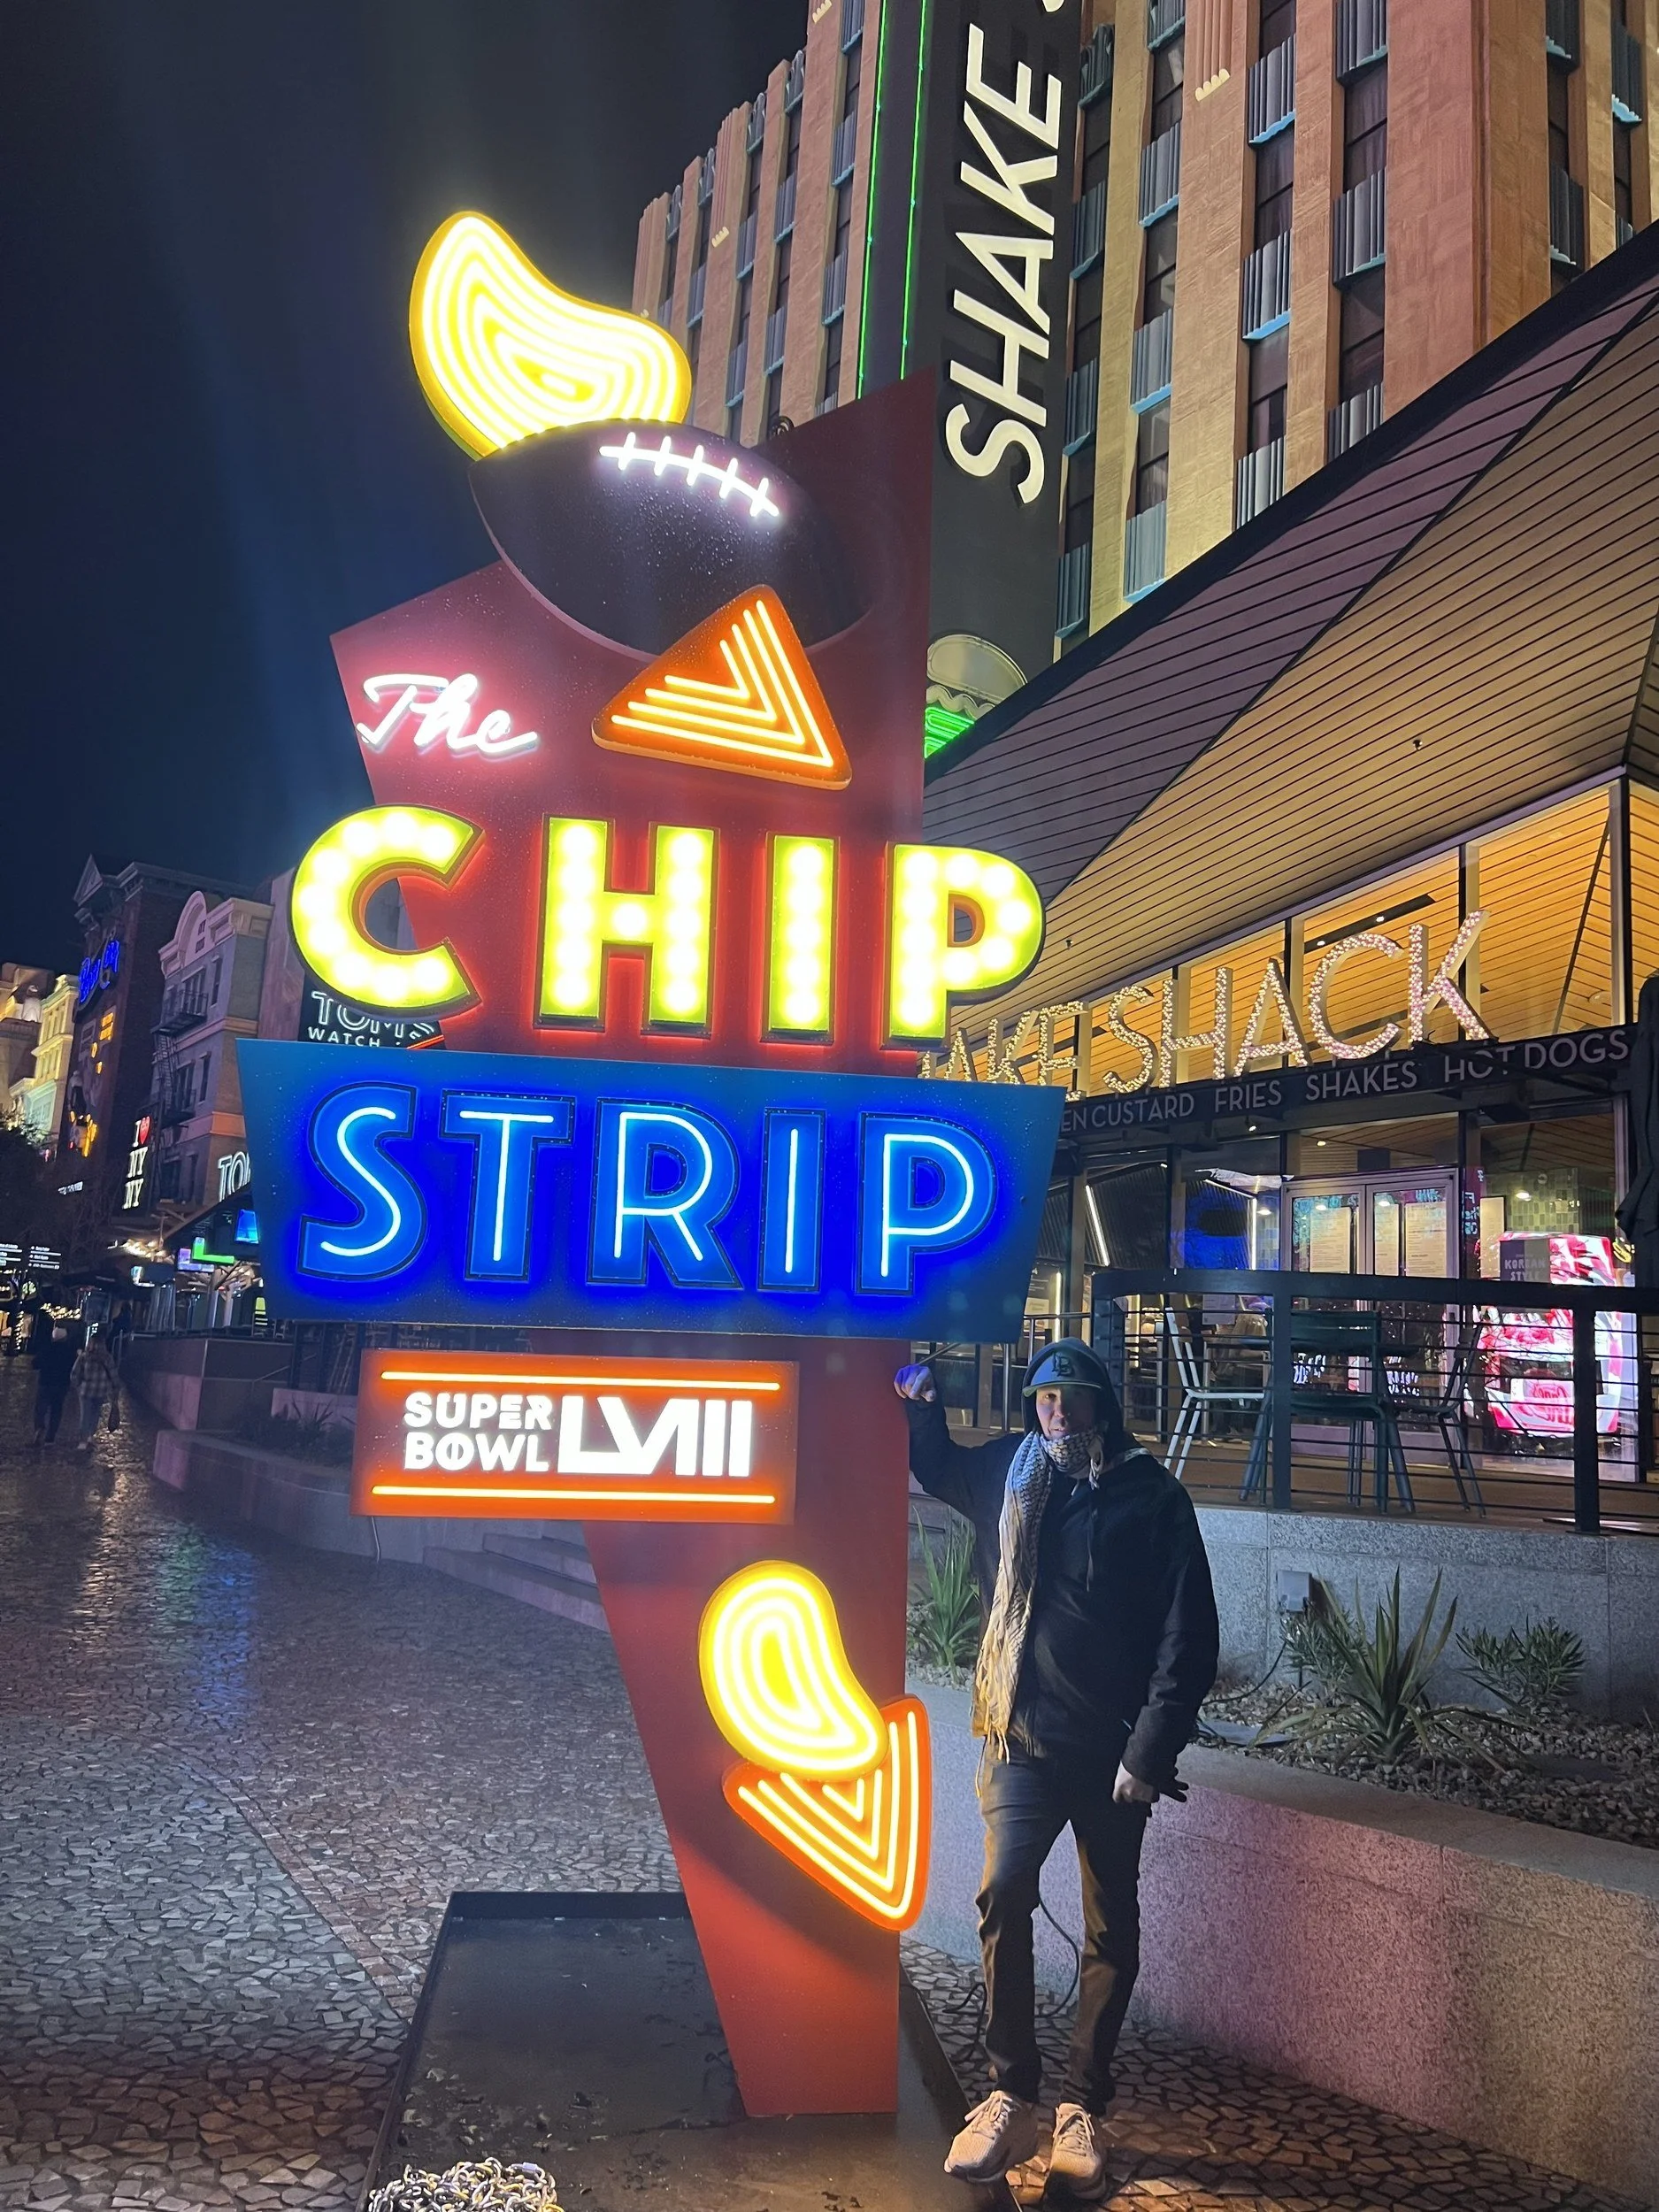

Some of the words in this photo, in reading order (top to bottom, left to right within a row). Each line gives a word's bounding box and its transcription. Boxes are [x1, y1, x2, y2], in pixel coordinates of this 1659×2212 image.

[946, 23, 1062, 504] SHAKE
[356, 672, 541, 756] The
[291, 804, 1045, 1048] CHIP
[307, 1026, 380, 1048] WATCH
[1102, 910, 1492, 1094] SHACK
[1091, 1092, 1194, 1128] CUSTARD
[1214, 1079, 1282, 1113] FRIES
[1305, 1060, 1417, 1102] SHAKES
[1444, 1045, 1516, 1083] HOT
[1524, 1029, 1630, 1070] DOGS
[218, 1151, 251, 1202] TO
[298, 1082, 997, 1294] STRIP
[403, 1392, 553, 1431] SUPER
[403, 1432, 550, 1472] BOWL
